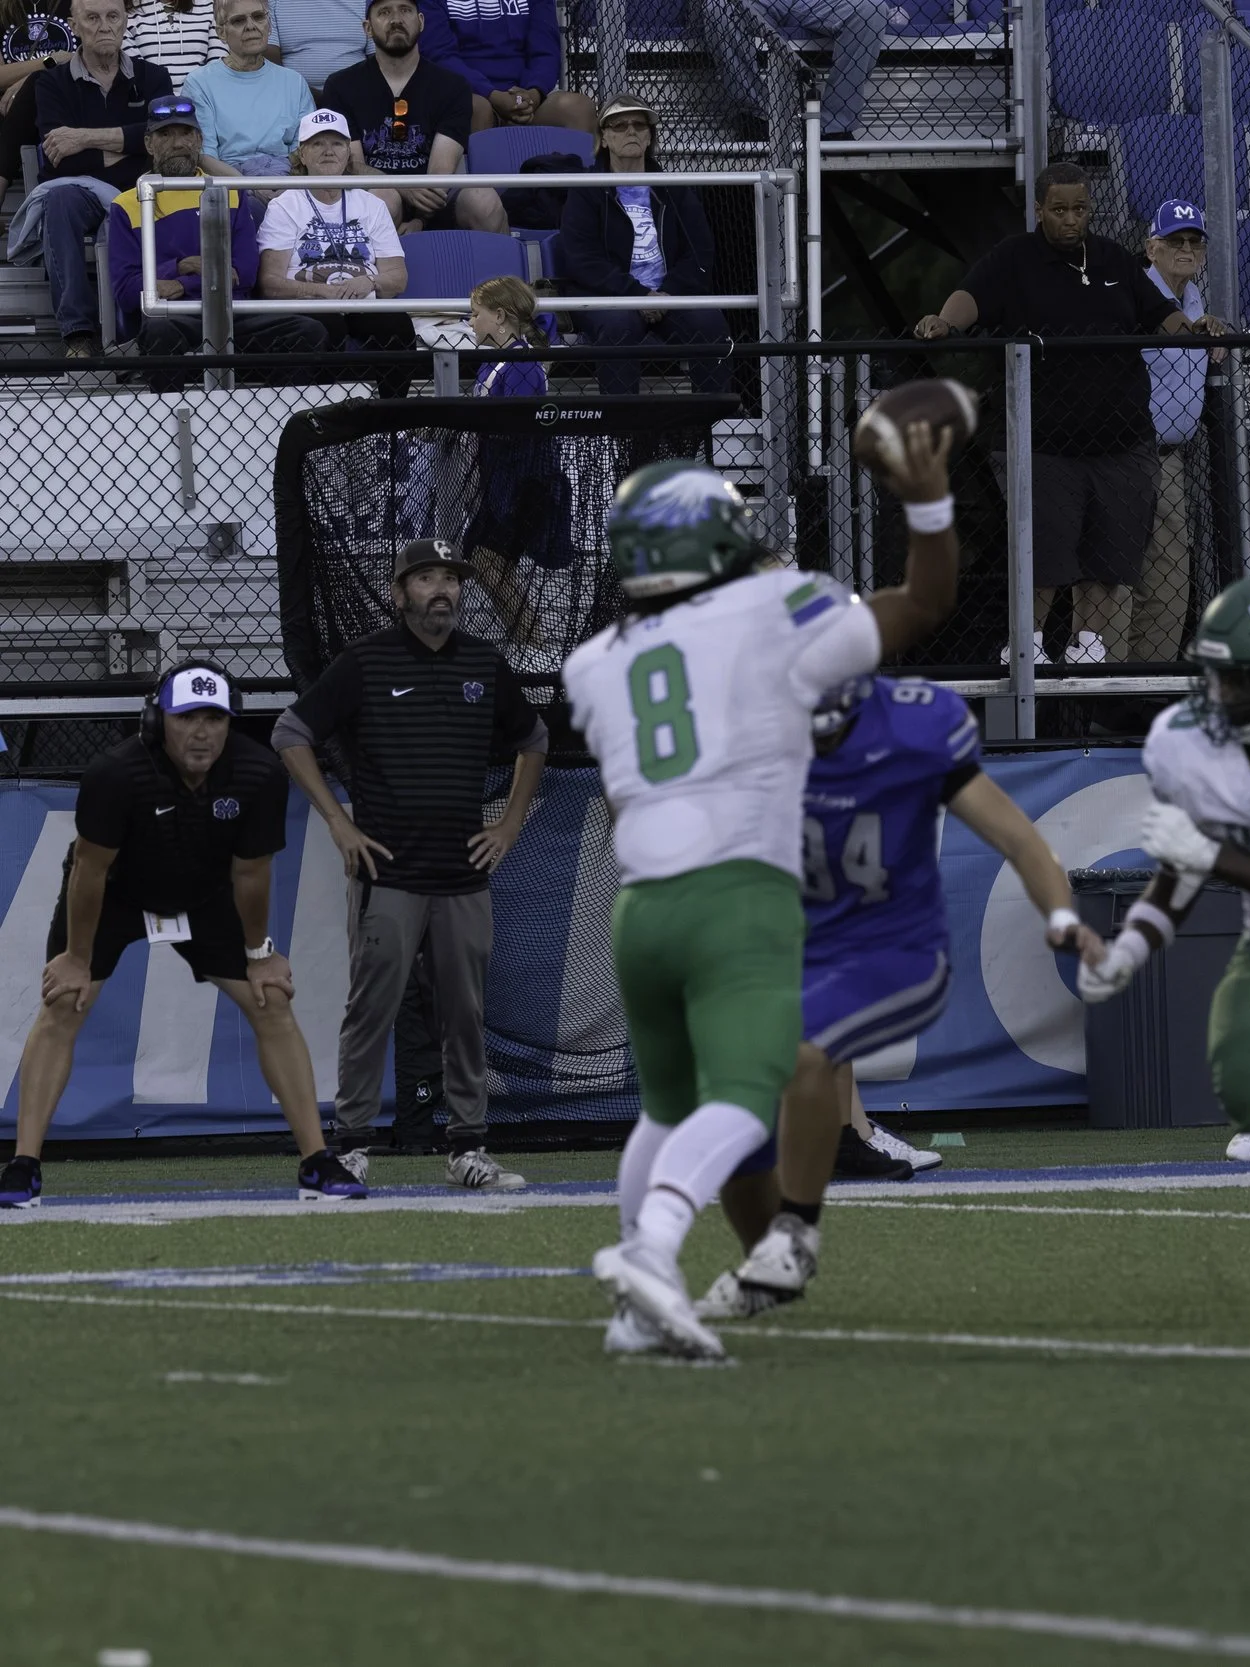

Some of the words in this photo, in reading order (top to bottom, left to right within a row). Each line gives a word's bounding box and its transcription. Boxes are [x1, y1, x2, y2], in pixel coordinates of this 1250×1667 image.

[1173, 205, 1196, 220] M
[301, 242, 321, 252] 2025
[535, 410, 556, 420] NET
[560, 410, 602, 419] RETURN
[626, 641, 700, 784] 8
